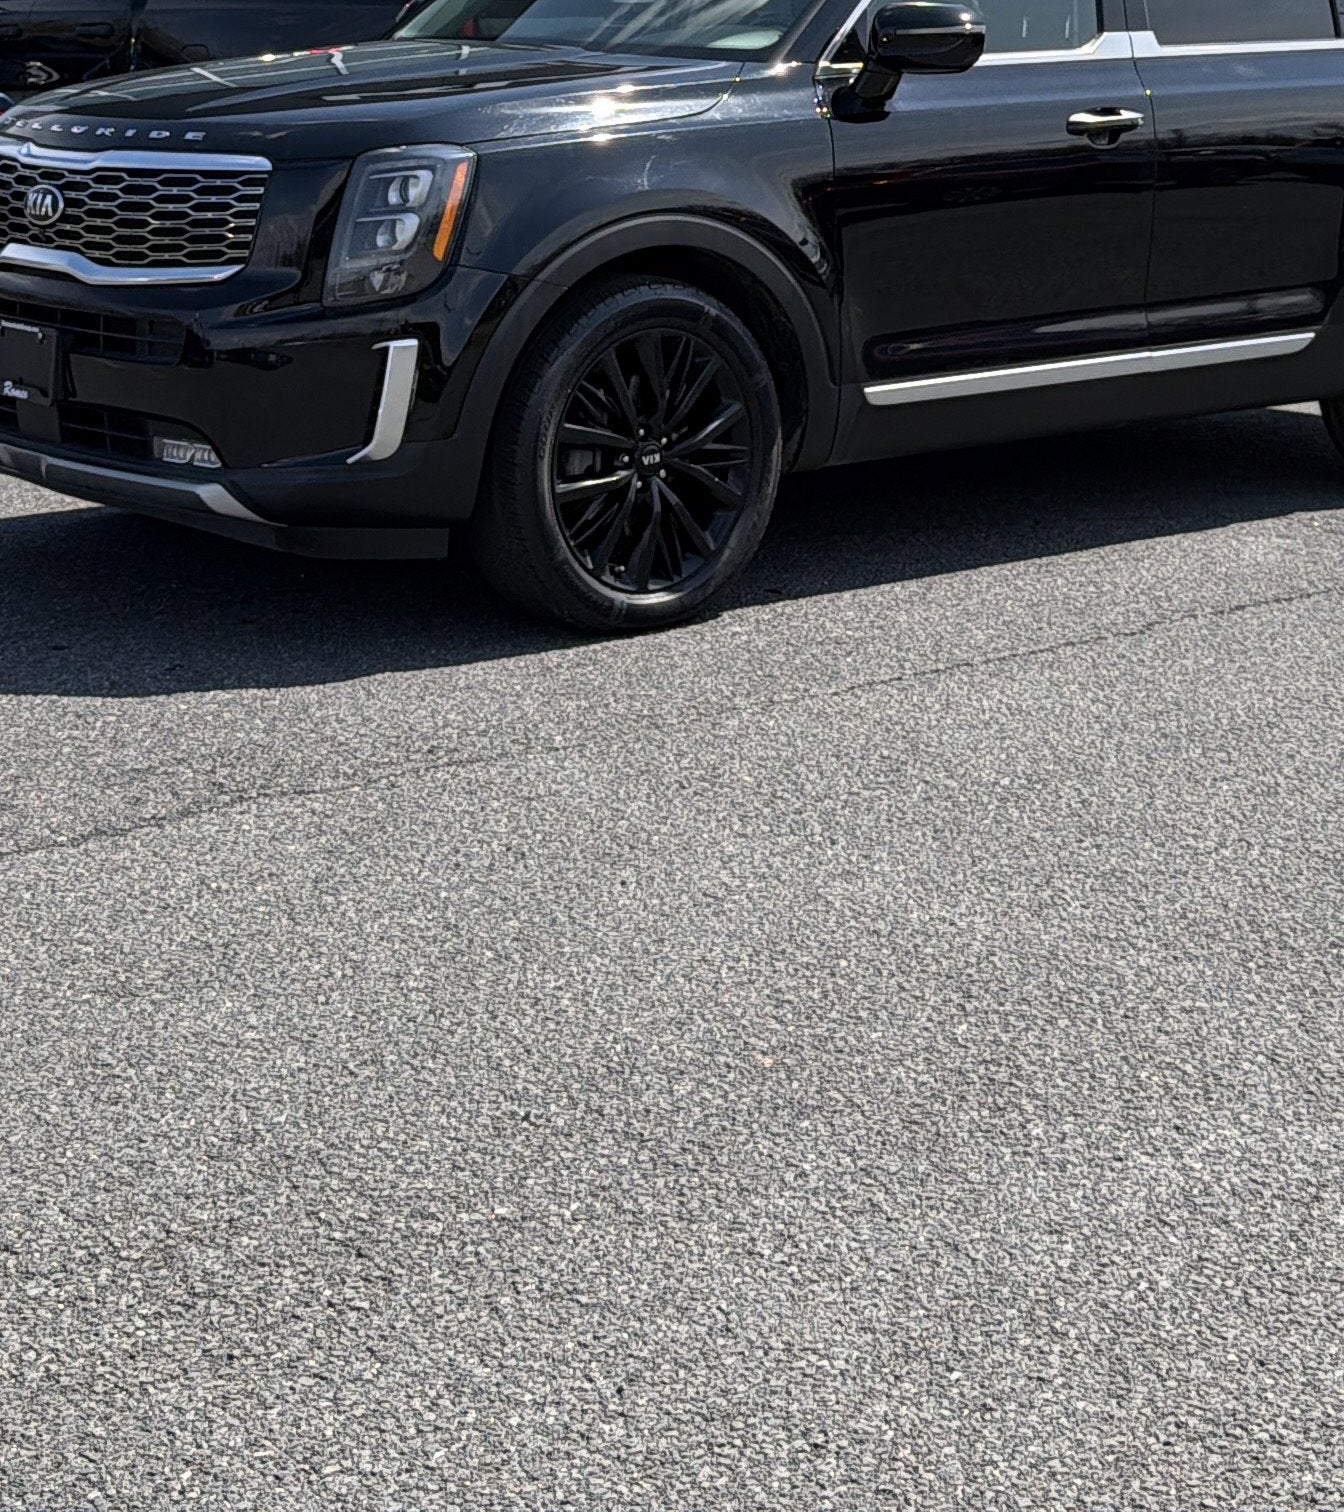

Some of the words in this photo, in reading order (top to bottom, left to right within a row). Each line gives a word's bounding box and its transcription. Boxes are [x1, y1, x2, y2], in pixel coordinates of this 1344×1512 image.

[4, 116, 206, 142] TELLURIDE
[27, 192, 53, 217] KIA
[641, 452, 661, 466] KIA
